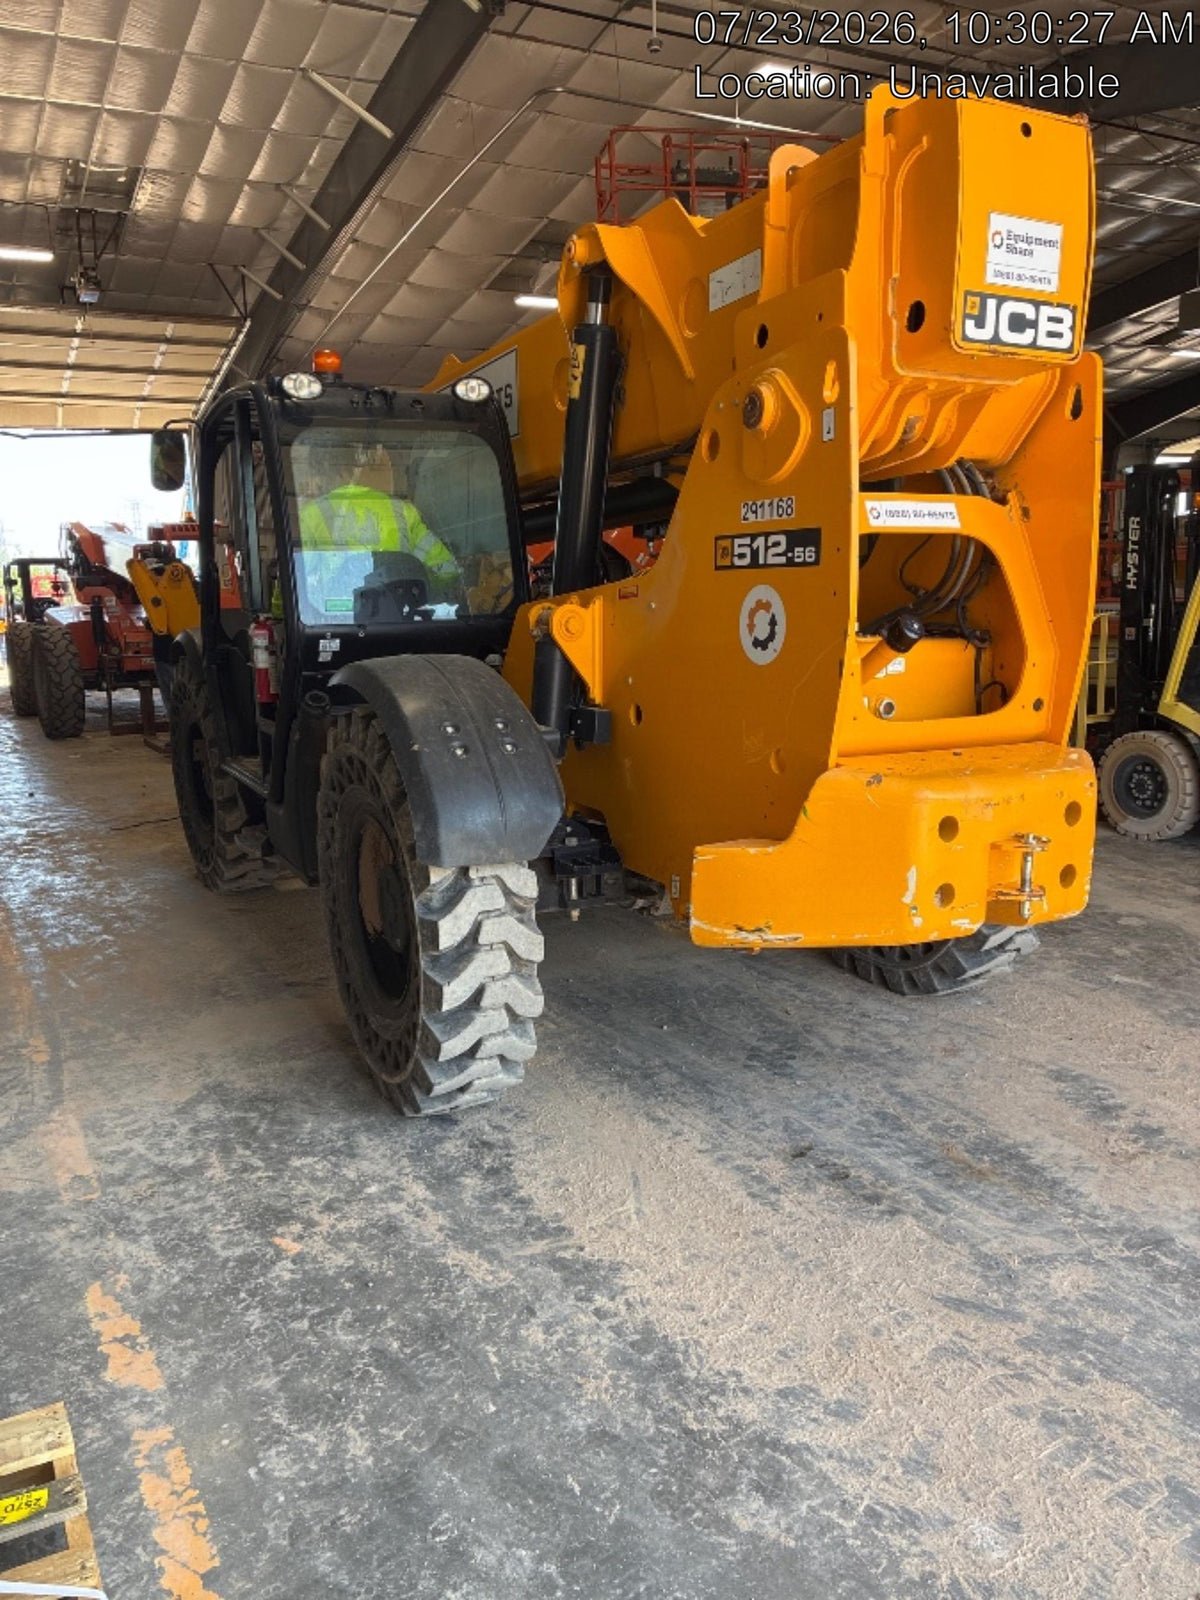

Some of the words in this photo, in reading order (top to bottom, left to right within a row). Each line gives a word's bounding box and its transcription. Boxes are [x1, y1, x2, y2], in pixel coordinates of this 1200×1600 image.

[1006, 229, 1059, 250] Equipment
[1006, 243, 1034, 258] Share
[965, 298, 1073, 349] JCB
[741, 497, 795, 522] 291168
[1126, 516, 1141, 590] HYSTER
